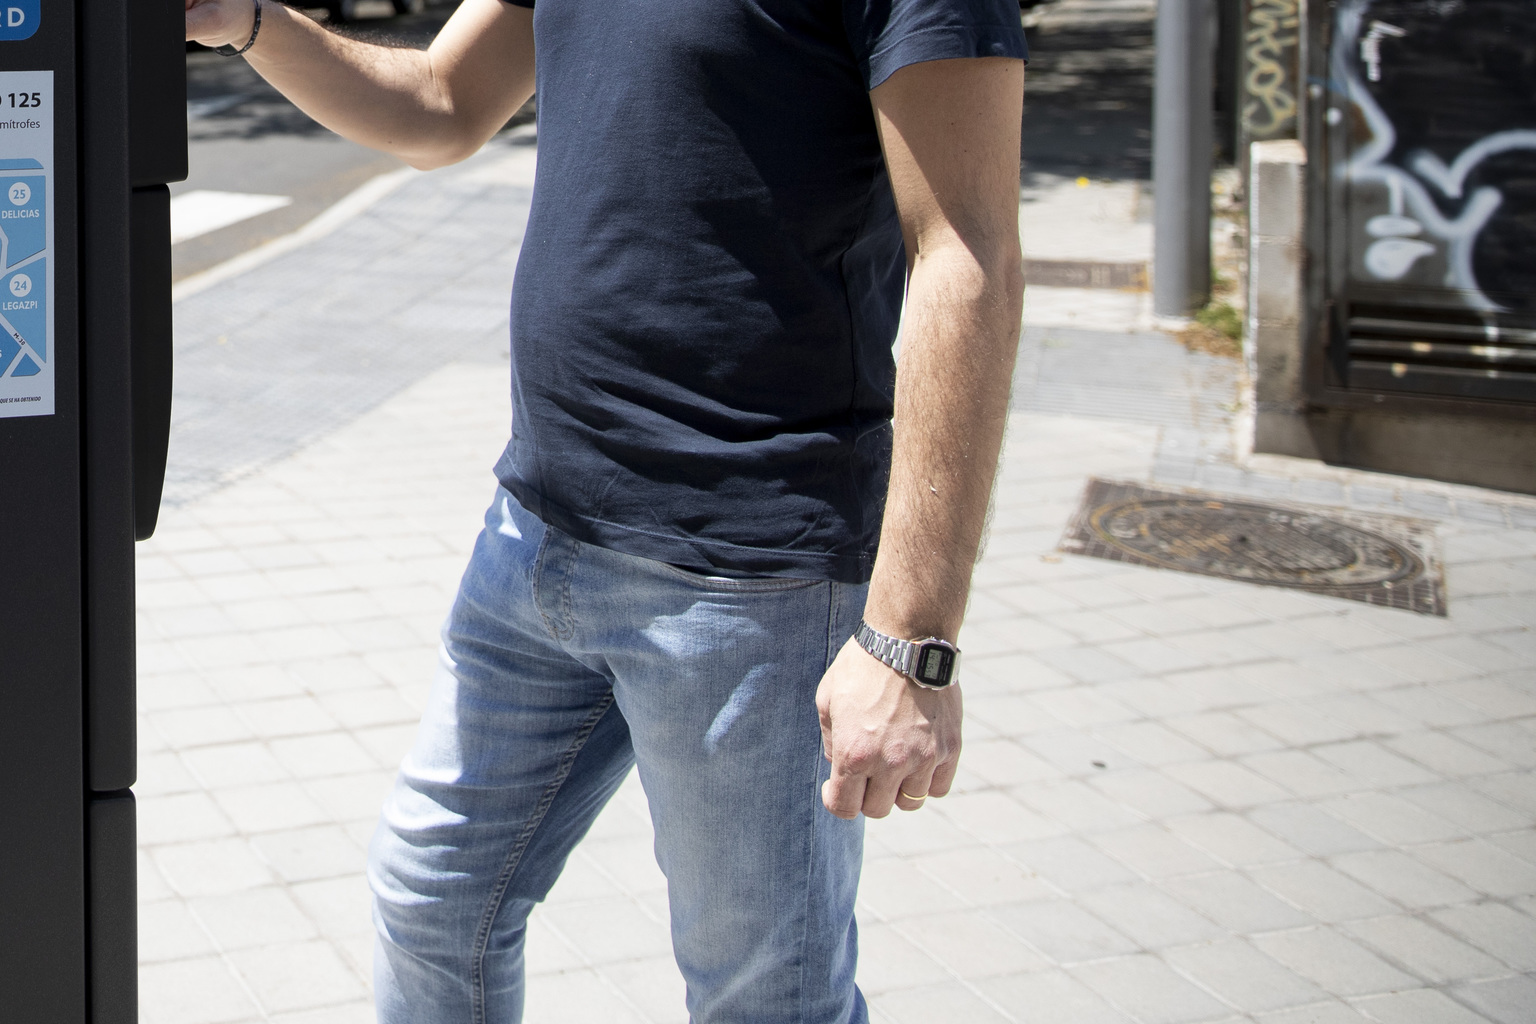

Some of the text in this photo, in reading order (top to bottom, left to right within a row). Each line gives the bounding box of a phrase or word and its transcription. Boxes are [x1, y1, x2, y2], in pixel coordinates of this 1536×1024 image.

[8, 92, 42, 108] 125
[12, 189, 26, 199] 25
[1, 209, 40, 220] DELICIAS
[14, 280, 27, 291] 24
[2, 300, 38, 311] LEGAZPI
